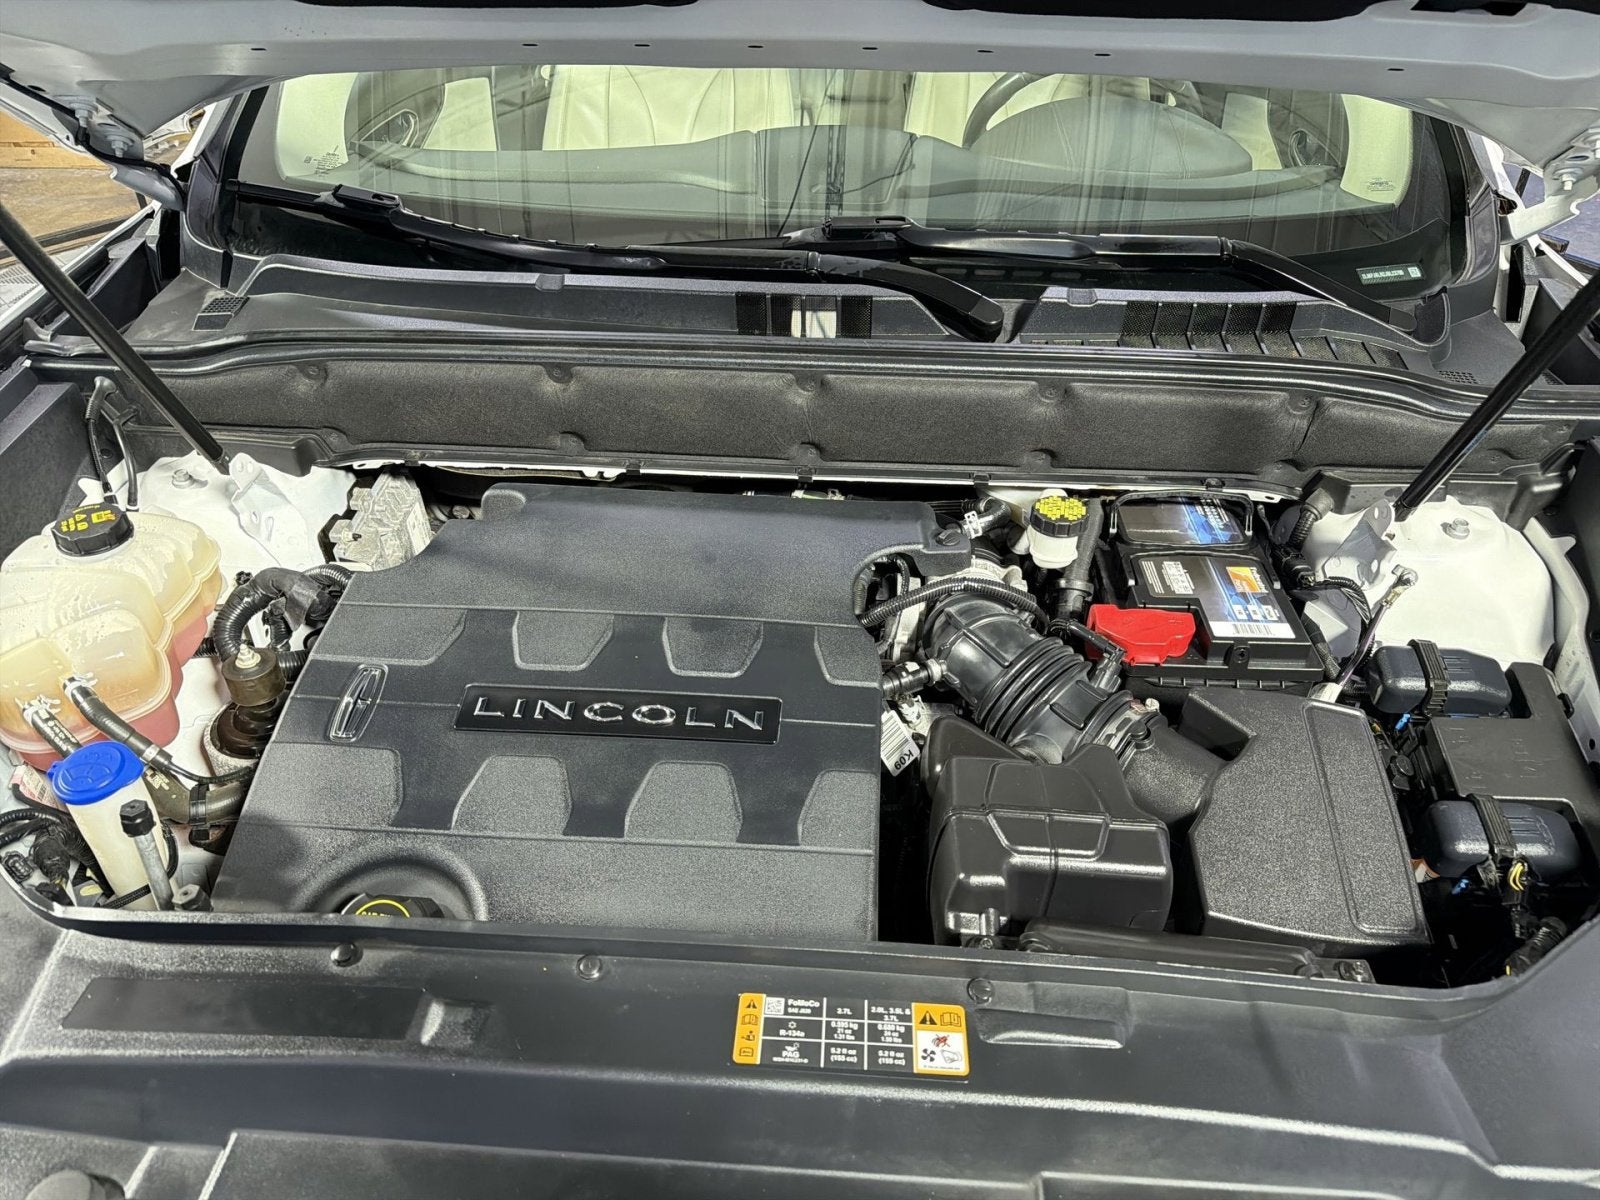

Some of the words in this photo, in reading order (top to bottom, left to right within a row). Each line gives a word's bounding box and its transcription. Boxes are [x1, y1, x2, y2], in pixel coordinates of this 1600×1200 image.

[473, 697, 764, 731] LINCOLN
[894, 749, 914, 770] K09
[849, 1022, 858, 1030] kg
[896, 1024, 905, 1033] kg
[779, 1029, 806, 1038] R-134a
[782, 1050, 800, 1058] PAG
